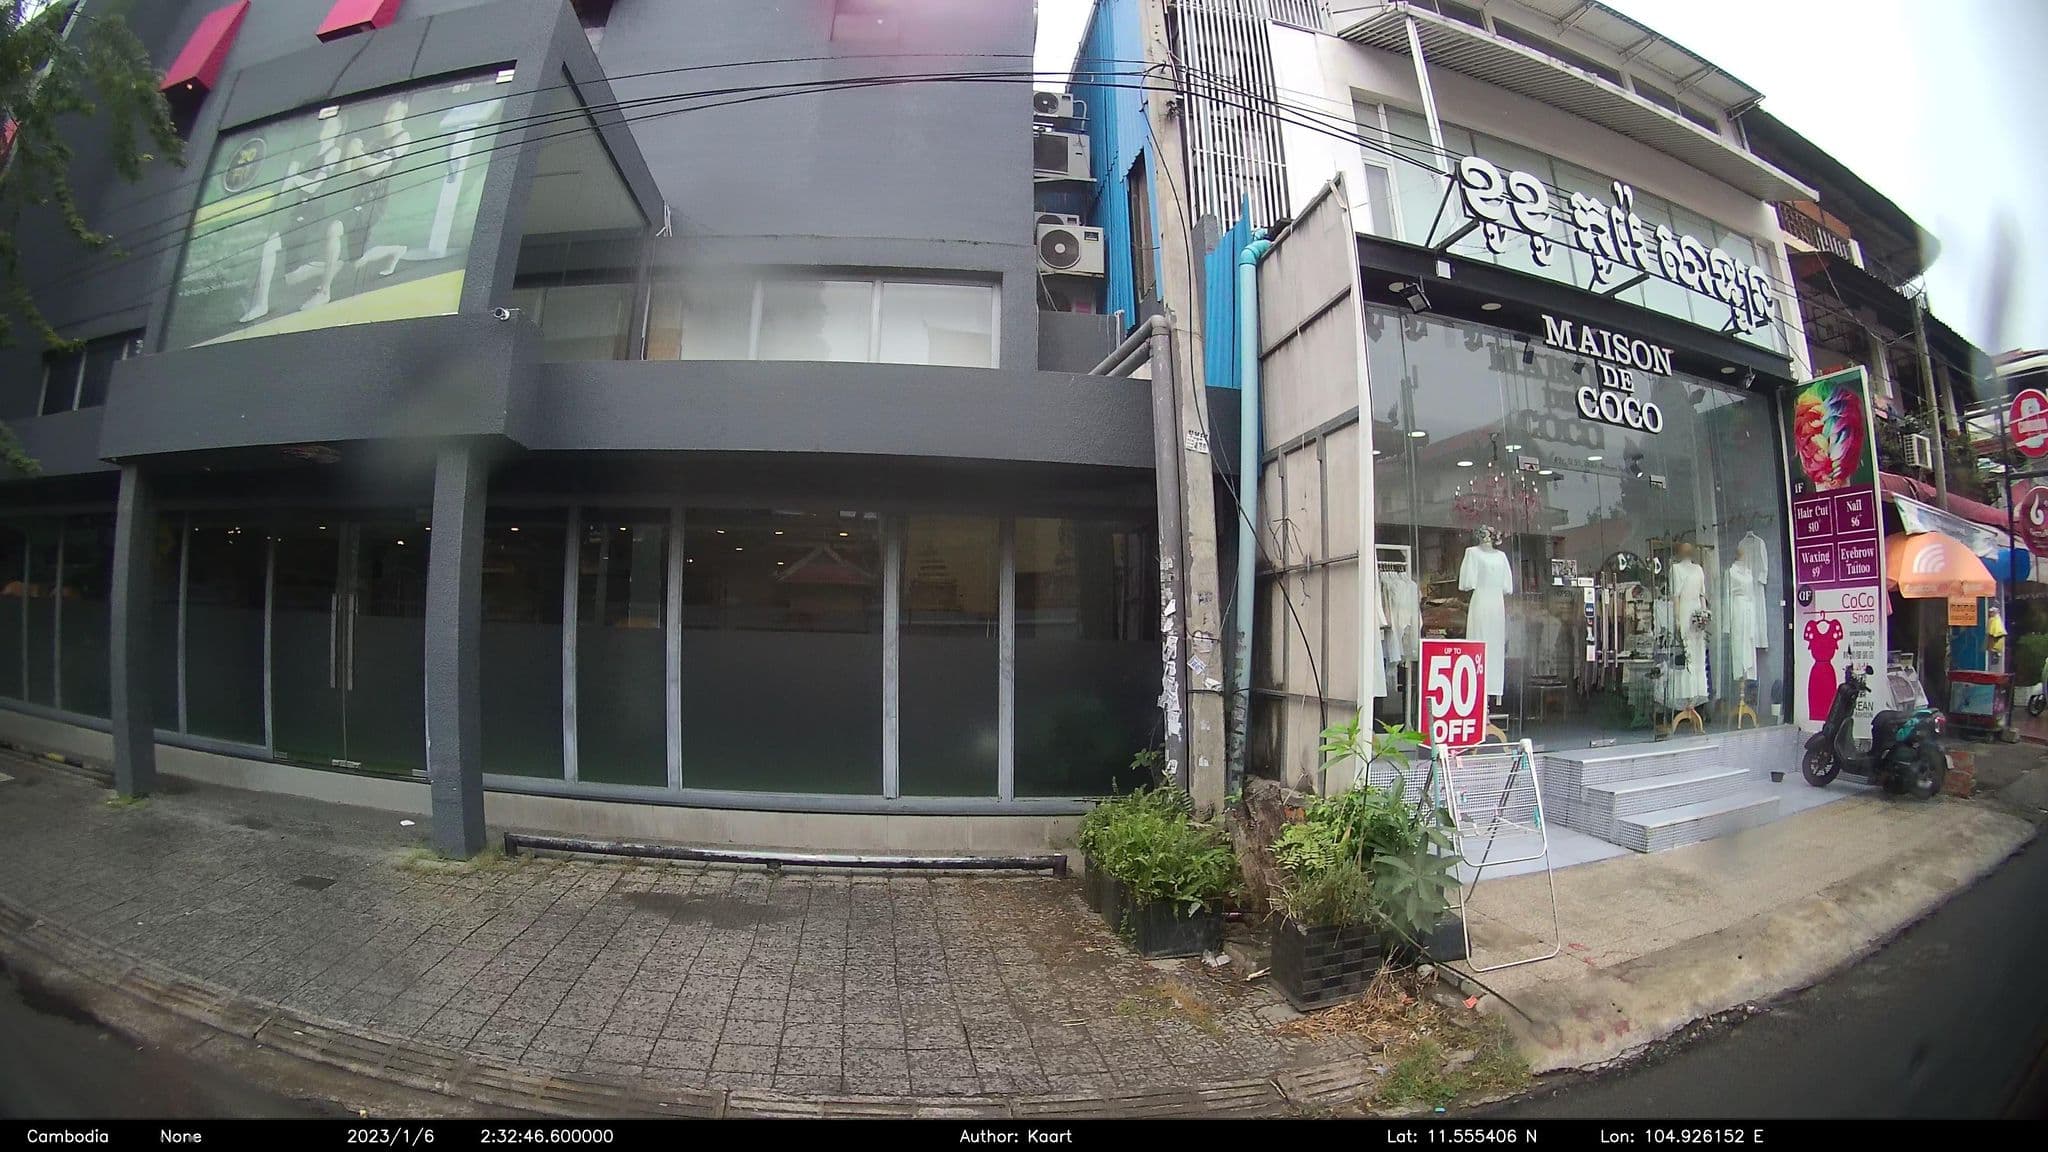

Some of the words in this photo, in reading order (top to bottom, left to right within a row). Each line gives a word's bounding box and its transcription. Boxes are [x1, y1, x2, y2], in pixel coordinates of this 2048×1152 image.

[1460, 156, 1554, 267] ខូខូ
[1541, 314, 1675, 377] MAISON
[1601, 363, 1635, 393] DE
[1575, 390, 1665, 434] COCO
[1797, 506, 1814, 520] Hair
[1814, 504, 1829, 517] Cut
[1846, 498, 1863, 512] Nail
[1801, 551, 1831, 565] Waxing
[1840, 547, 1875, 563] Eyebrow
[1845, 562, 1871, 575] Tattoo
[1841, 592, 1875, 609] CoCo
[1852, 612, 1875, 625] Shop
[1444, 647, 1453, 655] UP
[1453, 647, 1462, 655] TO
[1425, 653, 1484, 718] 50%
[1432, 718, 1476, 744] OFF
